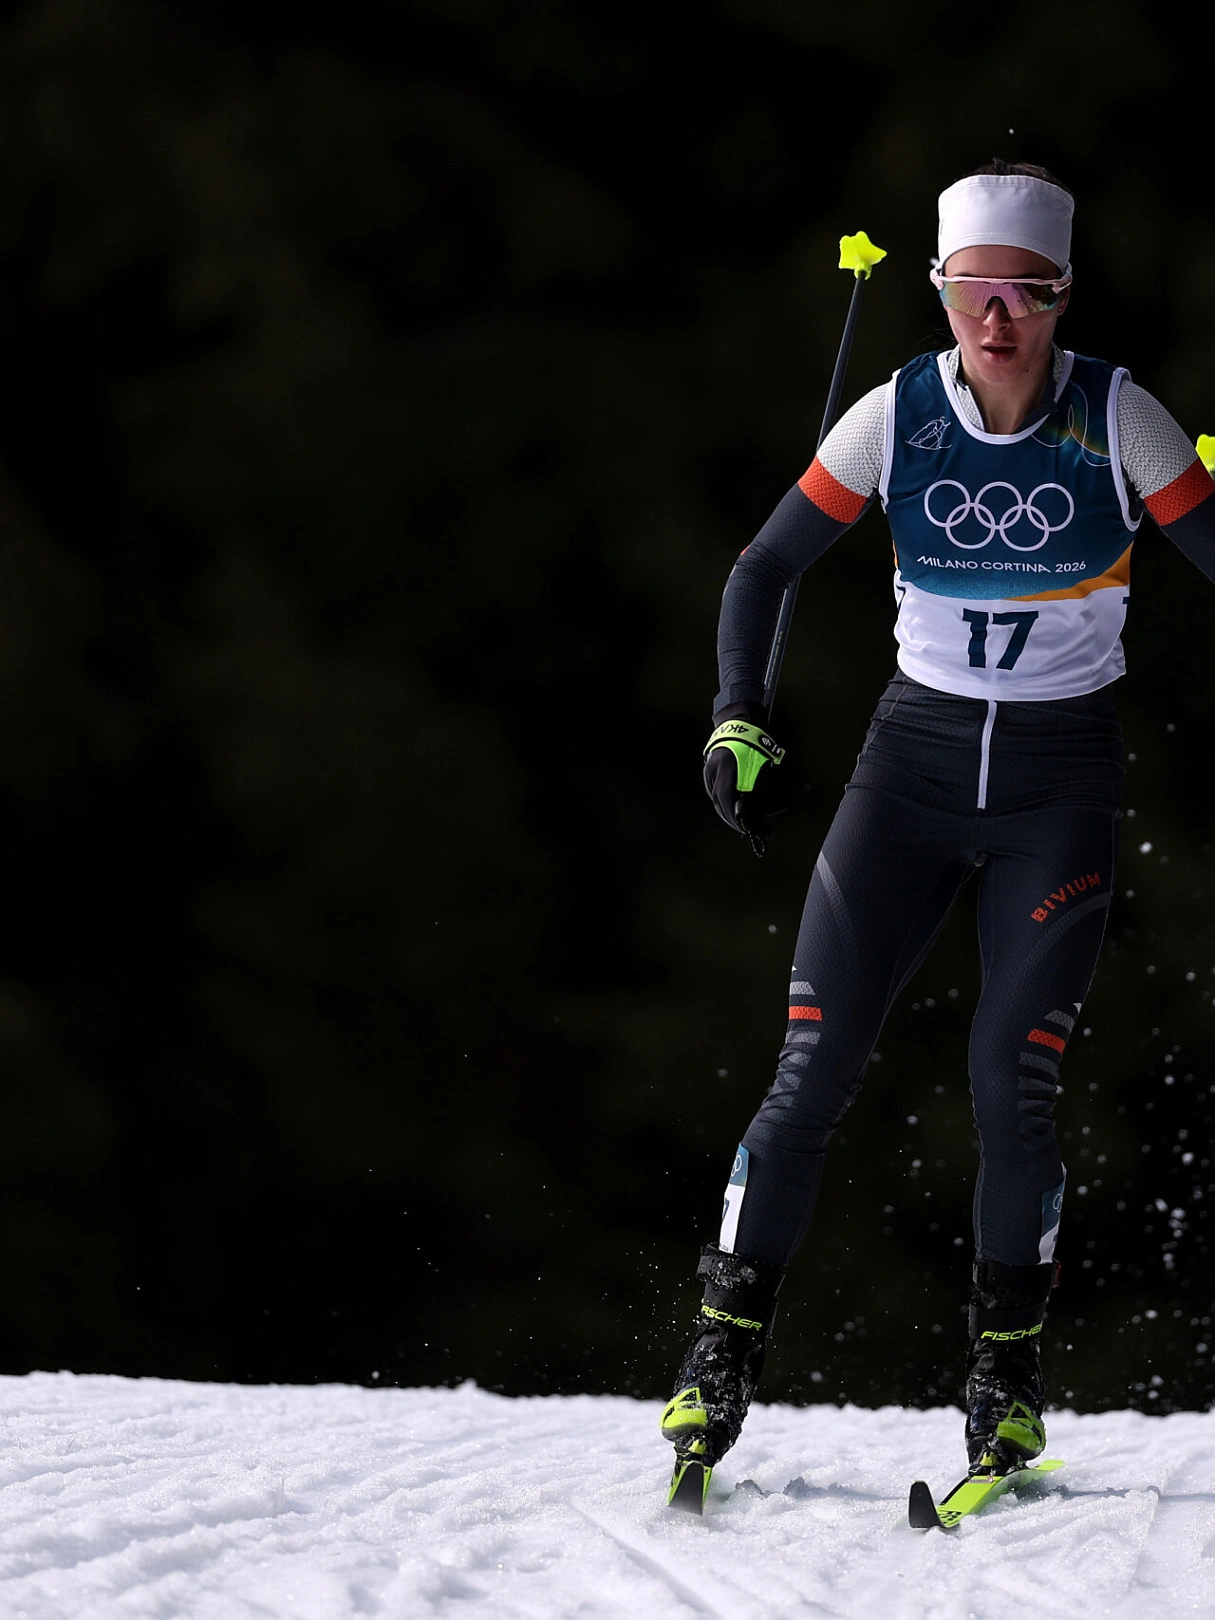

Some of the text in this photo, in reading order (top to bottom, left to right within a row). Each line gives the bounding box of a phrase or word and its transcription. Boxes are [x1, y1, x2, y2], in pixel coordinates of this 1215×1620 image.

[916, 555, 1086, 573] MILANO CORTINA 2026
[962, 608, 1039, 671] 17
[1030, 872, 1101, 923] BIVIUM
[701, 1305, 763, 1331] FISCHER
